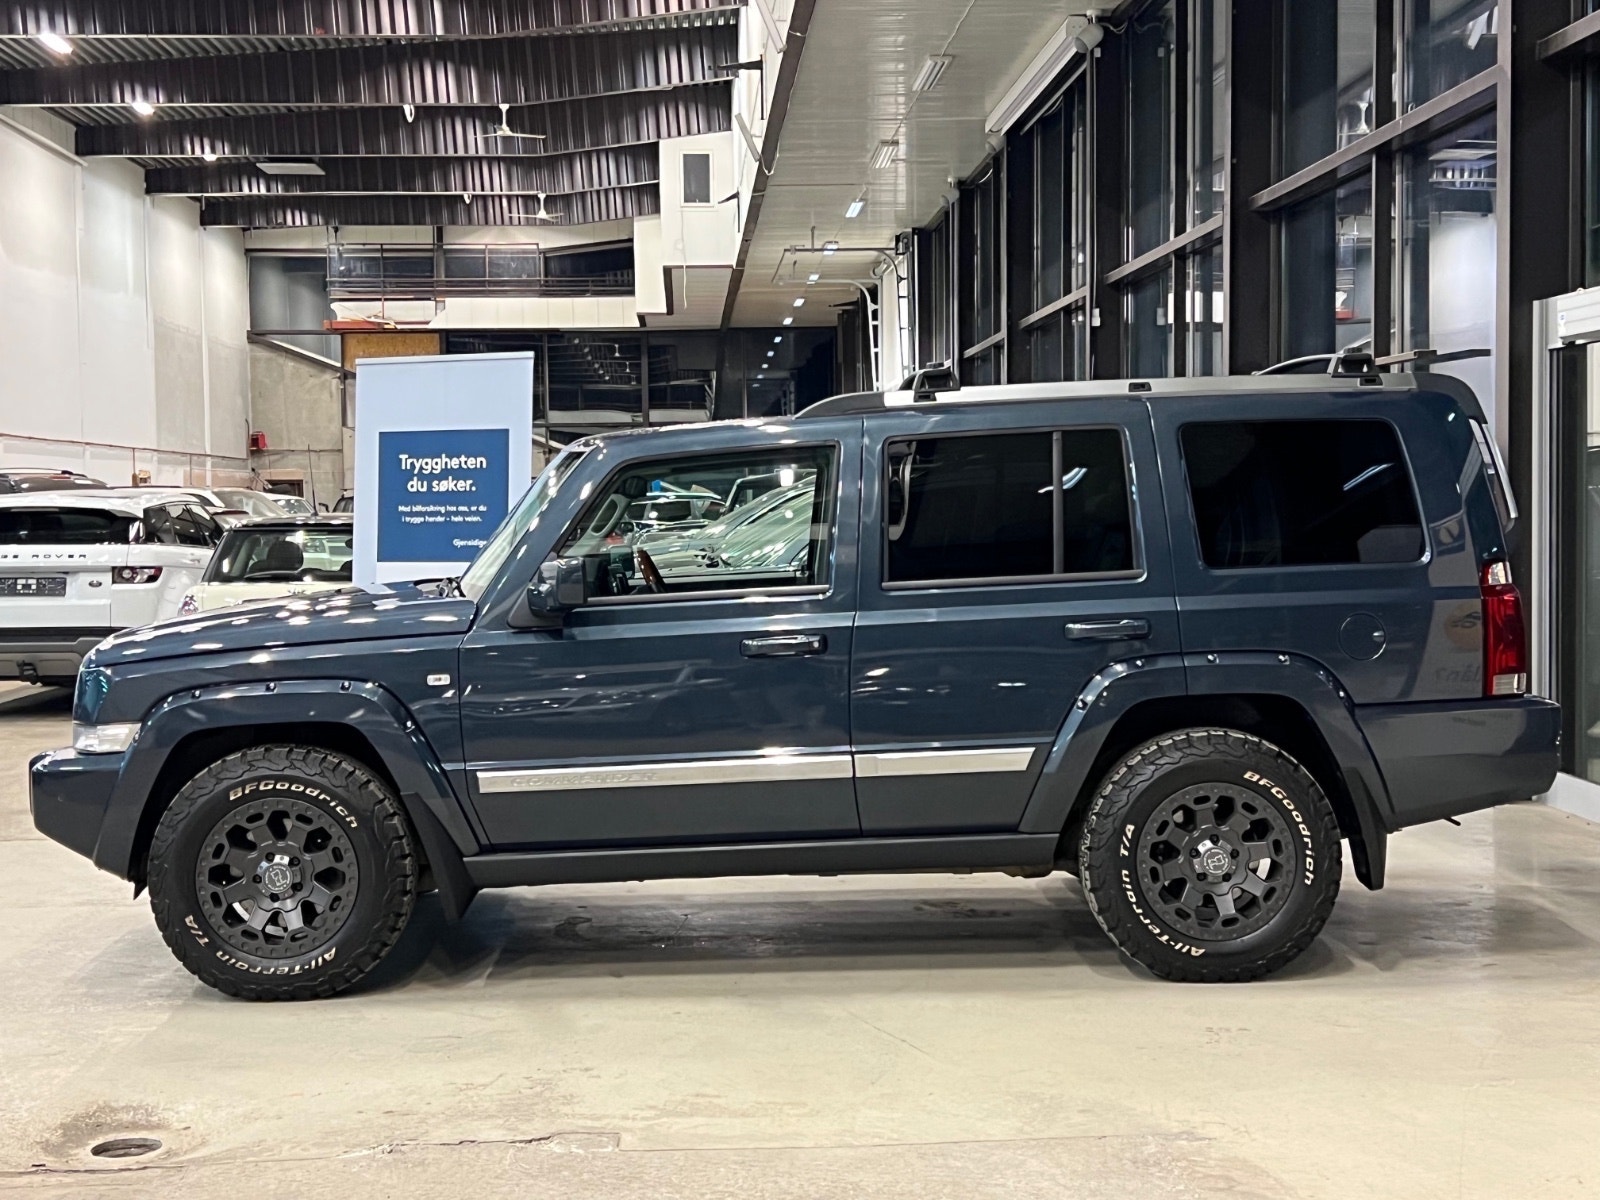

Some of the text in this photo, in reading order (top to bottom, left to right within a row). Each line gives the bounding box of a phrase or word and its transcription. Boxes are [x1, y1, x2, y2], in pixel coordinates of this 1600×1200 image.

[399, 454, 487, 474] Tryggheten
[407, 476, 476, 492] du søker.
[510, 772, 657, 787] COMMANDER
[229, 780, 358, 828] BFGoodrich
[1119, 823, 1135, 857] T/A
[1243, 770, 1314, 885] BFGoodrich
[1121, 869, 1206, 957] All-Terrain
[216, 946, 336, 976] All-Terrain
